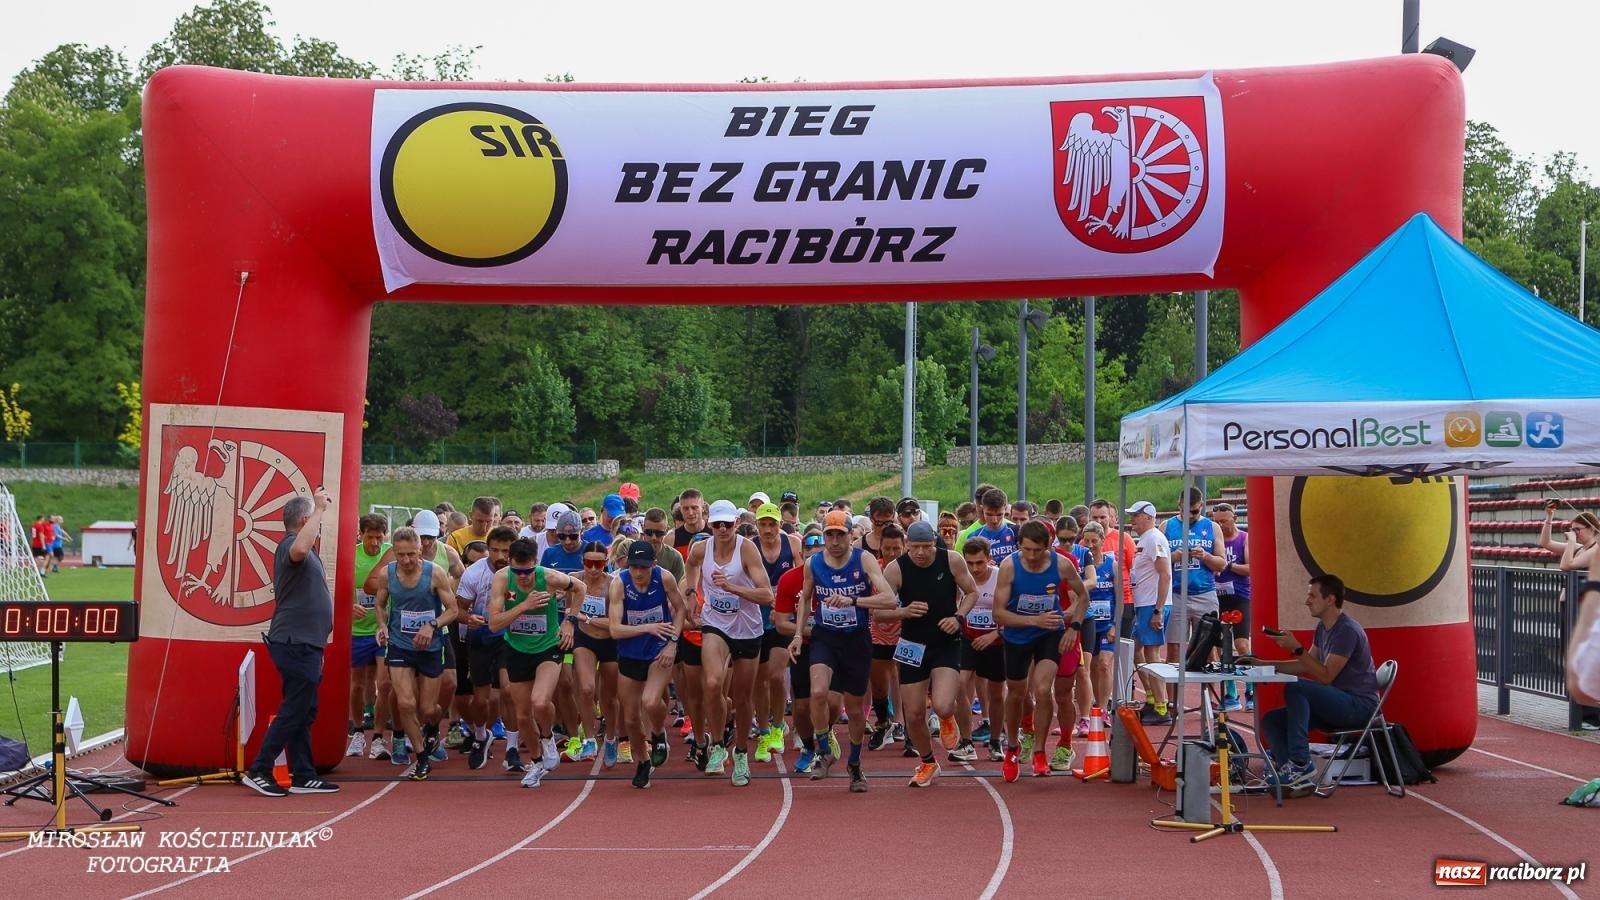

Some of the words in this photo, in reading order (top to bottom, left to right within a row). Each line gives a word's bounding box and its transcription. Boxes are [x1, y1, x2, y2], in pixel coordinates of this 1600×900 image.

[724, 105, 876, 137] BIEG
[470, 125, 563, 157] SIR
[614, 162, 744, 203] BEZ
[753, 158, 987, 202] GRANIC
[646, 217, 957, 265] RACIBÓRZ
[1223, 417, 1432, 451] PersonalBest
[582, 603, 597, 614] 173
[714, 599, 731, 609] 220
[1027, 602, 1045, 610] 251
[5, 608, 118, 634] 0:00:00
[830, 614, 847, 622] 163
[973, 615, 990, 624] 190
[519, 622, 537, 631] 158
[900, 647, 914, 658] 193
